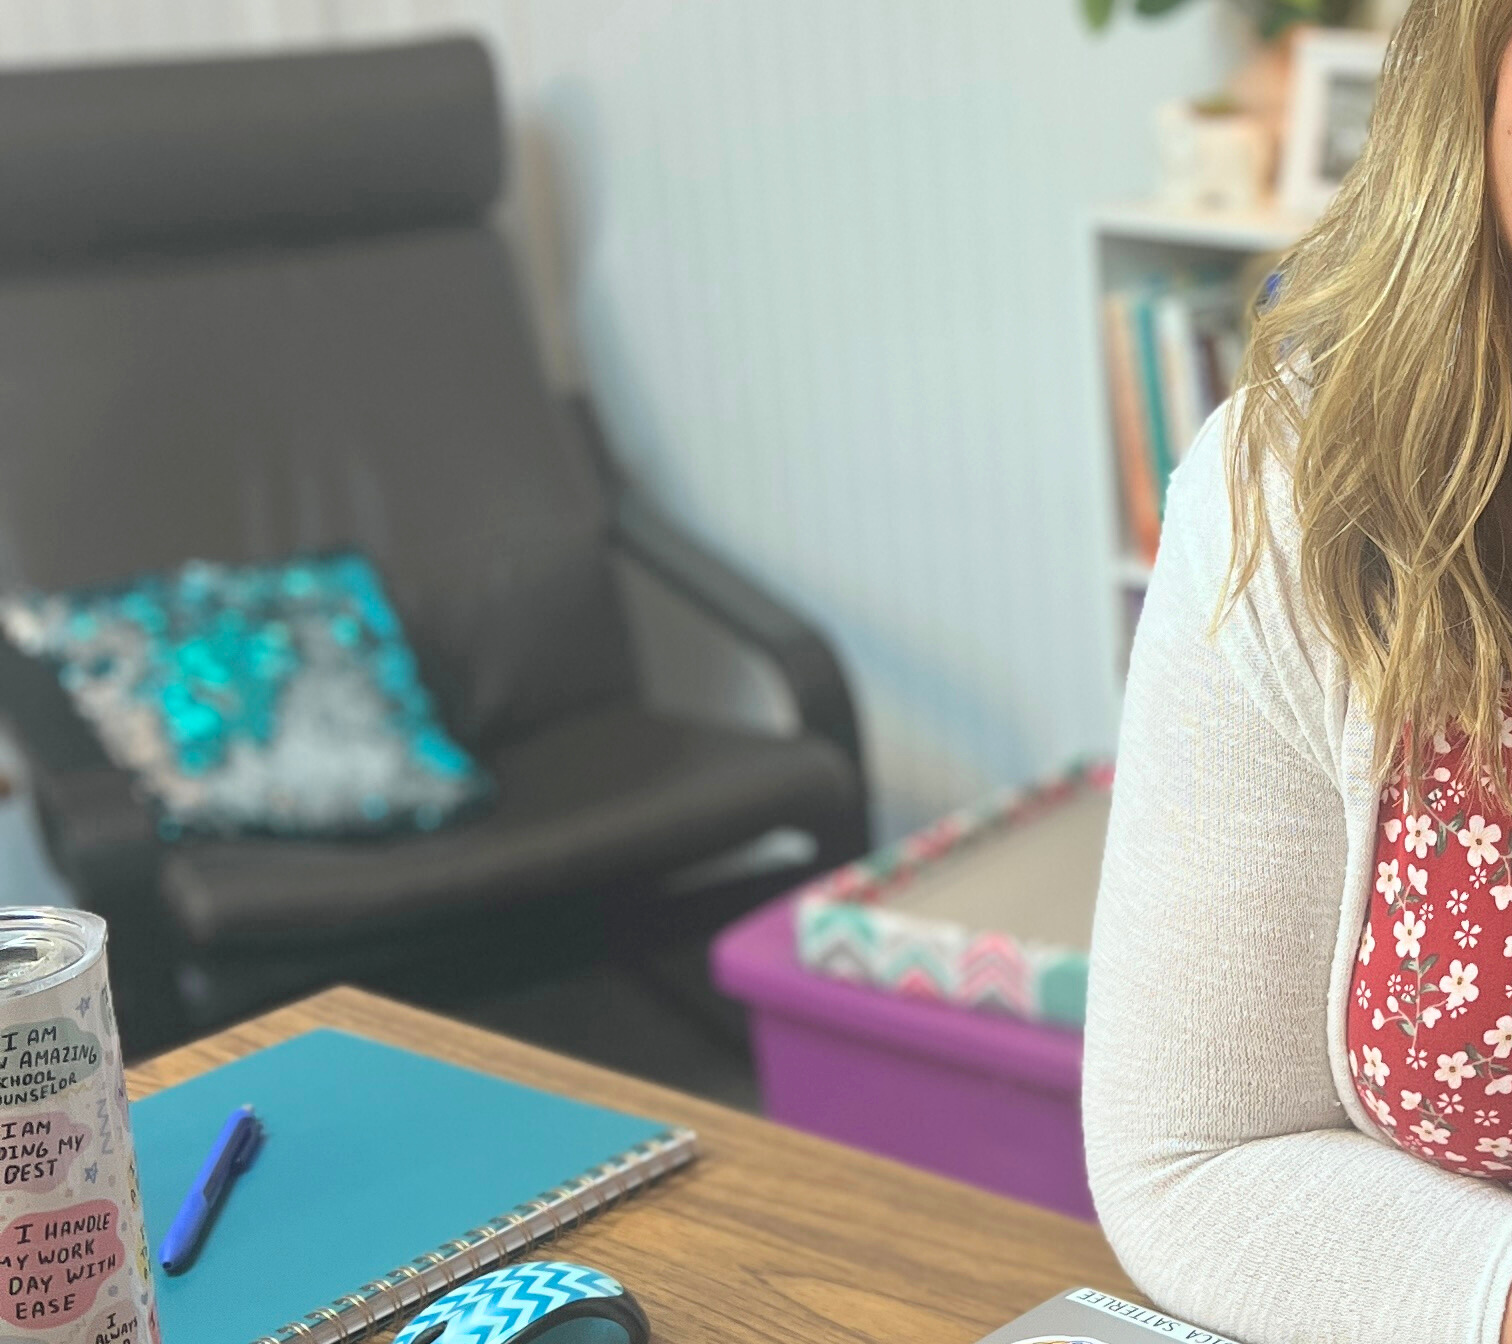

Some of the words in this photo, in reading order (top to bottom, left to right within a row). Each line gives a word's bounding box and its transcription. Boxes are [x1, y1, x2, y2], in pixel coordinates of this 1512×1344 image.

[1, 1032, 18, 1053] I
[28, 1026, 57, 1046] AM
[19, 1044, 97, 1070] AMAZING
[0, 1070, 56, 1089] CHOOL
[1, 1122, 17, 1141] I
[22, 1120, 51, 1138] AM
[58, 1134, 85, 1155] MY
[4, 1158, 58, 1185] BEST
[14, 1223, 34, 1244] I
[45, 1212, 111, 1241] HANDLE
[38, 1239, 95, 1265] WORK
[9, 1275, 53, 1296] DAY
[67, 1253, 116, 1285] WITH
[16, 1294, 76, 1320] EASE
[1077, 1290, 1181, 1332] SATTERLEE
[106, 1312, 117, 1329] I
